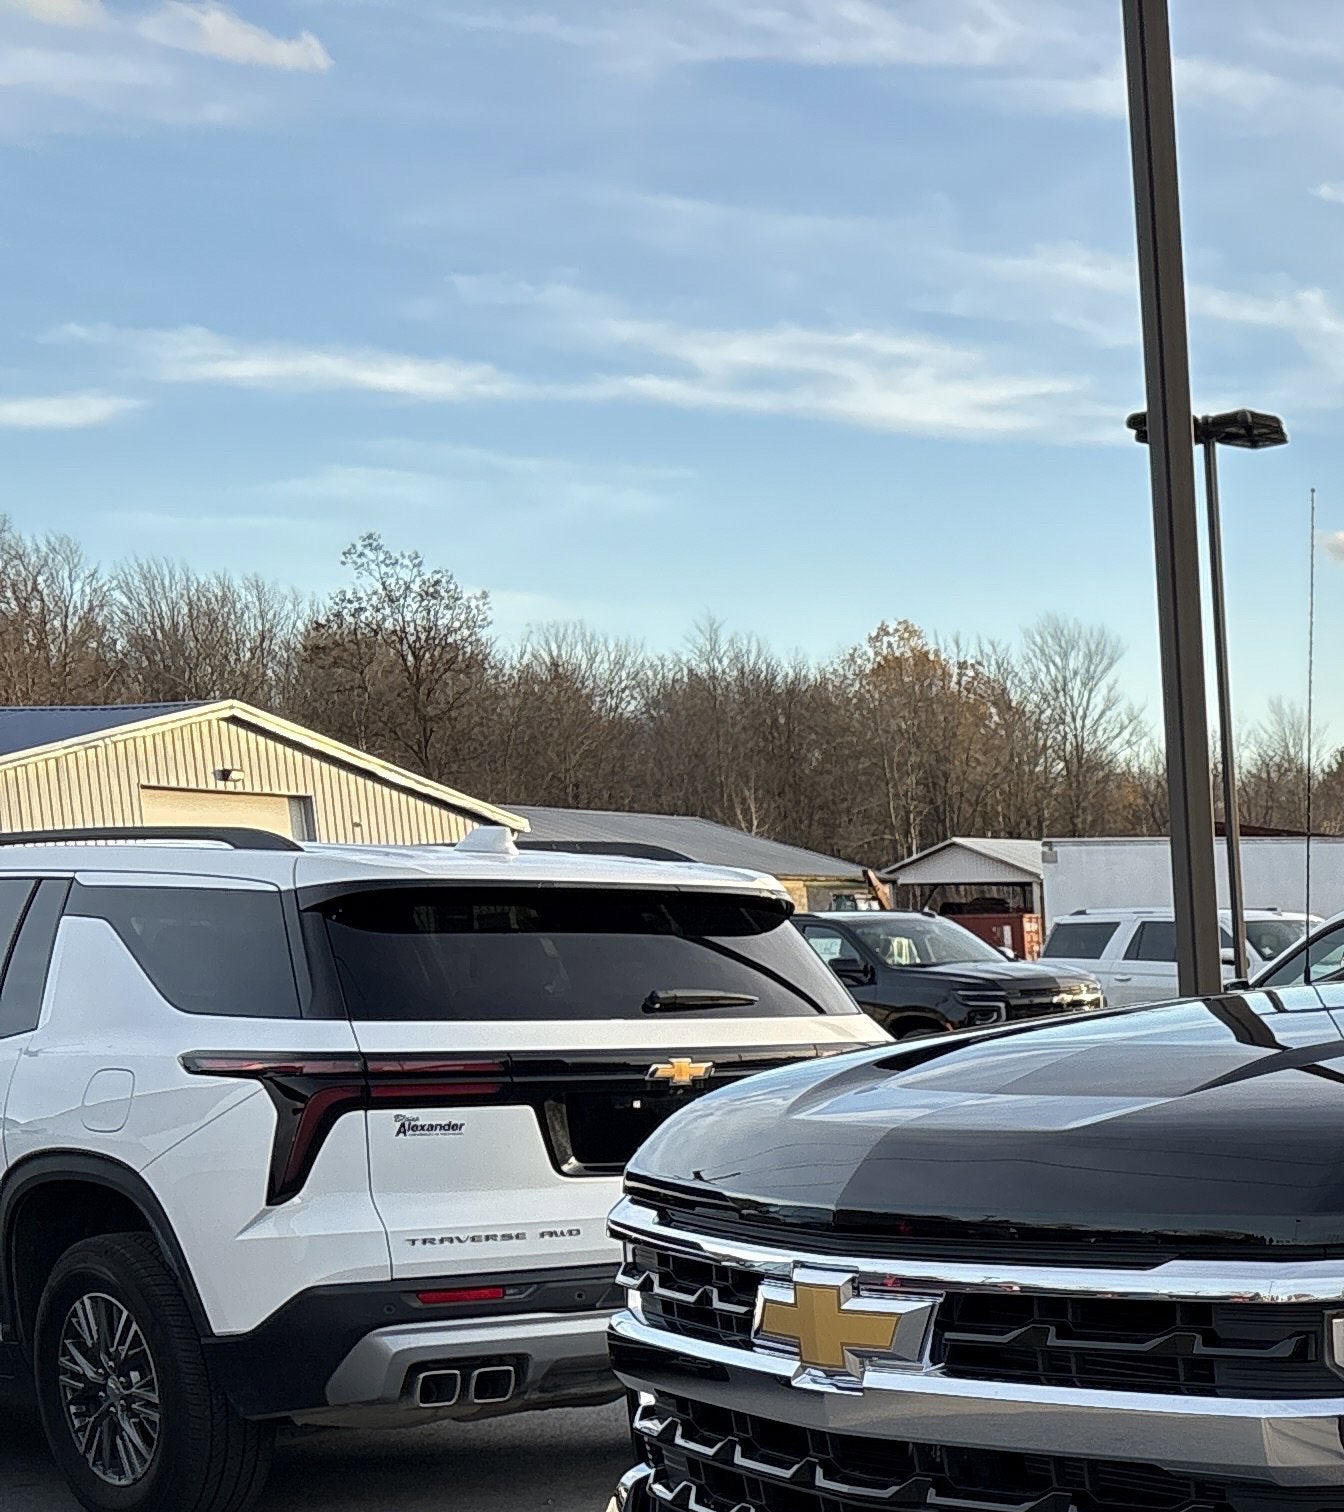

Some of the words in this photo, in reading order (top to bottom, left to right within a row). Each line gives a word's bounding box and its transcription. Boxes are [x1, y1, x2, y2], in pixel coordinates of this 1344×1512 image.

[395, 1121, 465, 1137] Alexander
[405, 1232, 527, 1246] TRAVERSE
[539, 1228, 581, 1239] AWD
